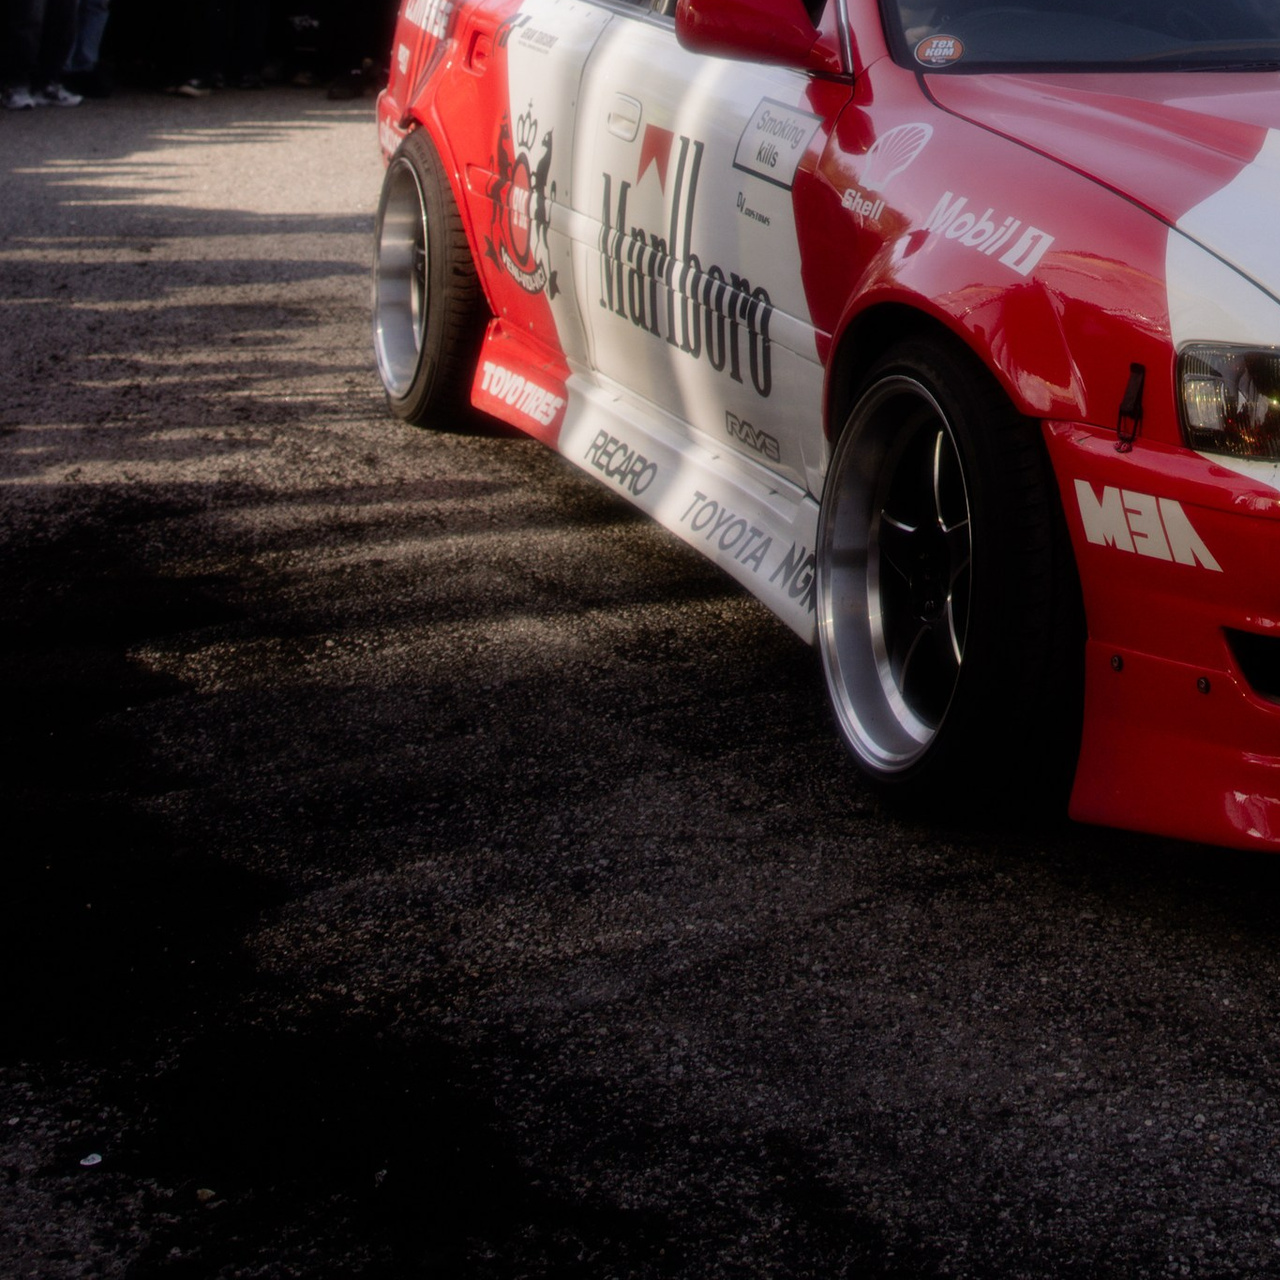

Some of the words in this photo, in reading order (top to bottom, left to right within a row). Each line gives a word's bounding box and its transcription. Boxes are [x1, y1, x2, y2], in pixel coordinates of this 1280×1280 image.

[756, 110, 806, 148] Smoking
[756, 141, 779, 168] kills
[841, 189, 886, 220] Shell
[925, 191, 1021, 256] Mobil
[599, 135, 772, 398] Marlboro
[584, 429, 658, 497] RECARO
[725, 410, 781, 464] RAYS
[679, 490, 773, 573] TOYOTA
